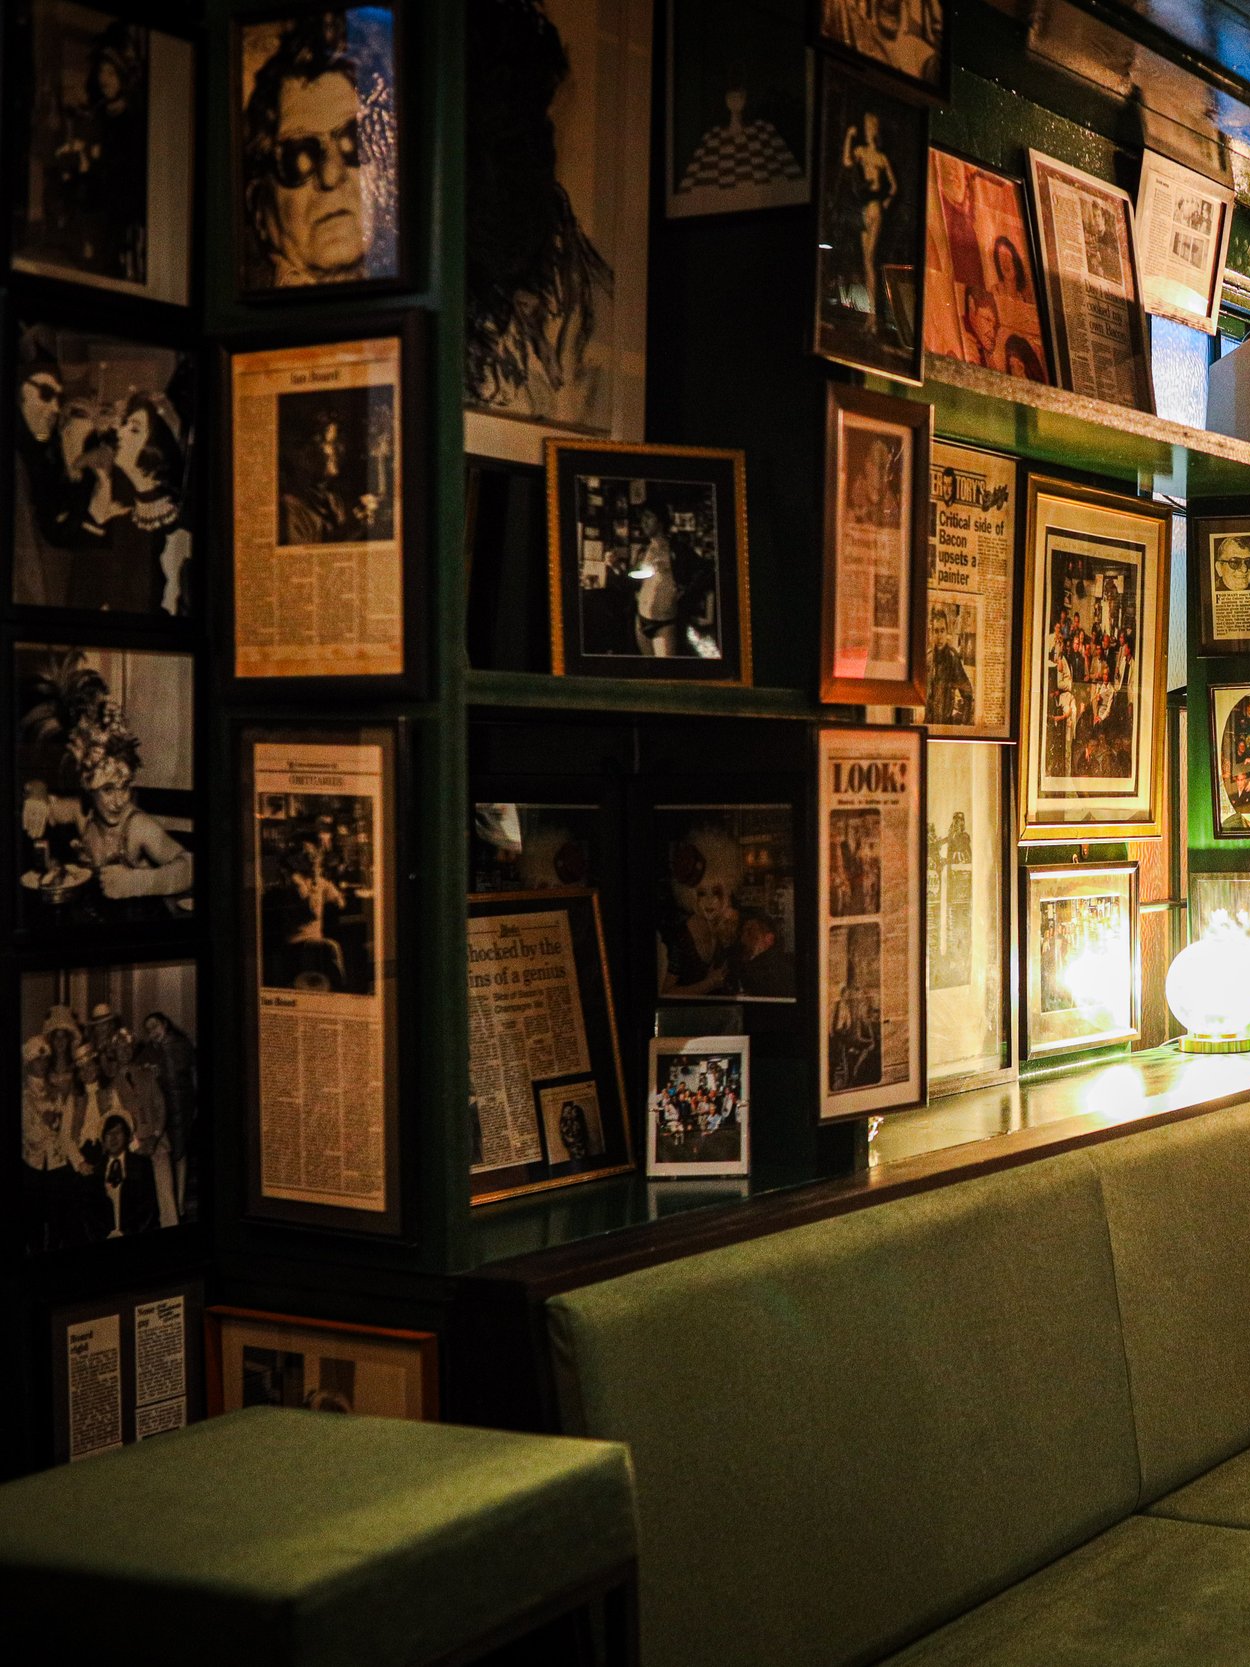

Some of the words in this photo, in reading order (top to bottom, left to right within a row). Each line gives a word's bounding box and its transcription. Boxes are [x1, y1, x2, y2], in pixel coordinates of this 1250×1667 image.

[940, 511, 970, 530] Critical
[974, 517, 991, 534] side
[996, 521, 1004, 535] of
[939, 529, 967, 548] Bacon
[939, 551, 968, 567] upsets
[938, 568, 969, 586] painter
[833, 762, 907, 793] LOOK!
[520, 938, 537, 961] by
[540, 936, 561, 956] the
[494, 966, 508, 985] of
[511, 970, 520, 983] a
[523, 961, 567, 987] genius
